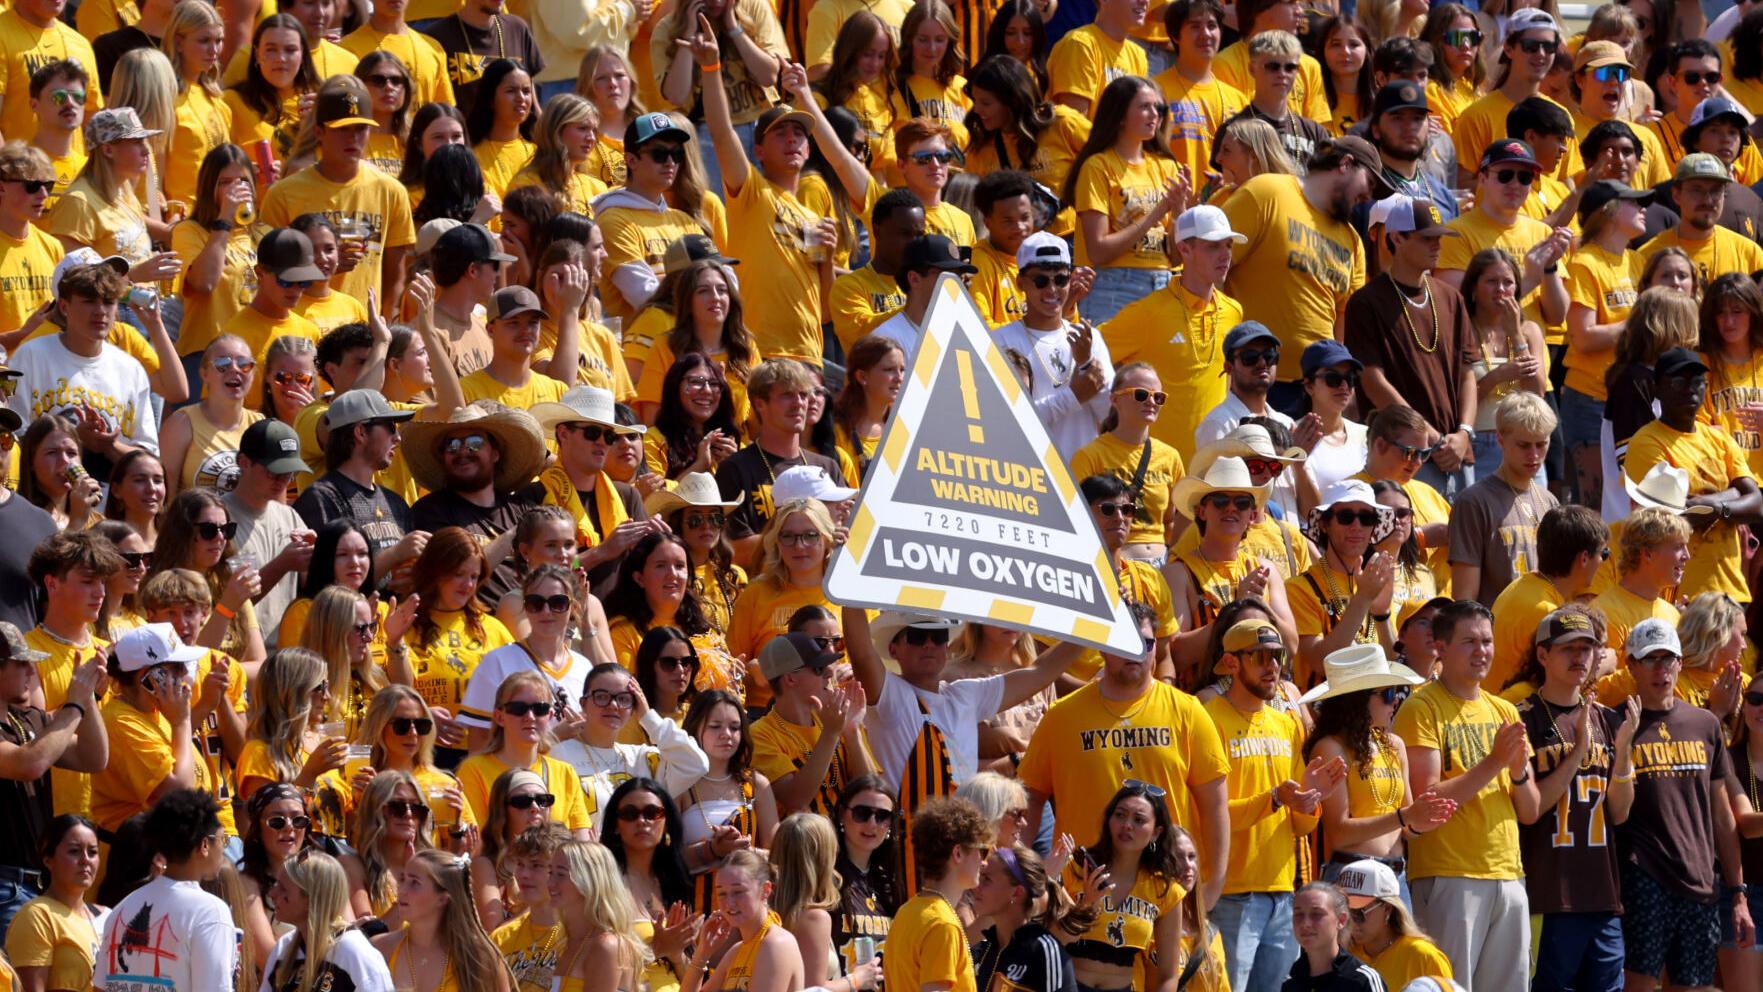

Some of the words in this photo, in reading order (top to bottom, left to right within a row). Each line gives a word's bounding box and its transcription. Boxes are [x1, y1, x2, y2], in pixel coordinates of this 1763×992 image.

[917, 448, 1047, 493] ALTITUDE
[931, 479, 1039, 516] WARNING
[924, 511, 981, 535] 7220
[998, 524, 1052, 548] FEET
[883, 538, 961, 575] LOW
[969, 552, 1095, 604] OXYGEN
[1080, 727, 1171, 751] WYOMING
[1632, 741, 1707, 765] WYOMING
[1552, 775, 1608, 847] 17
